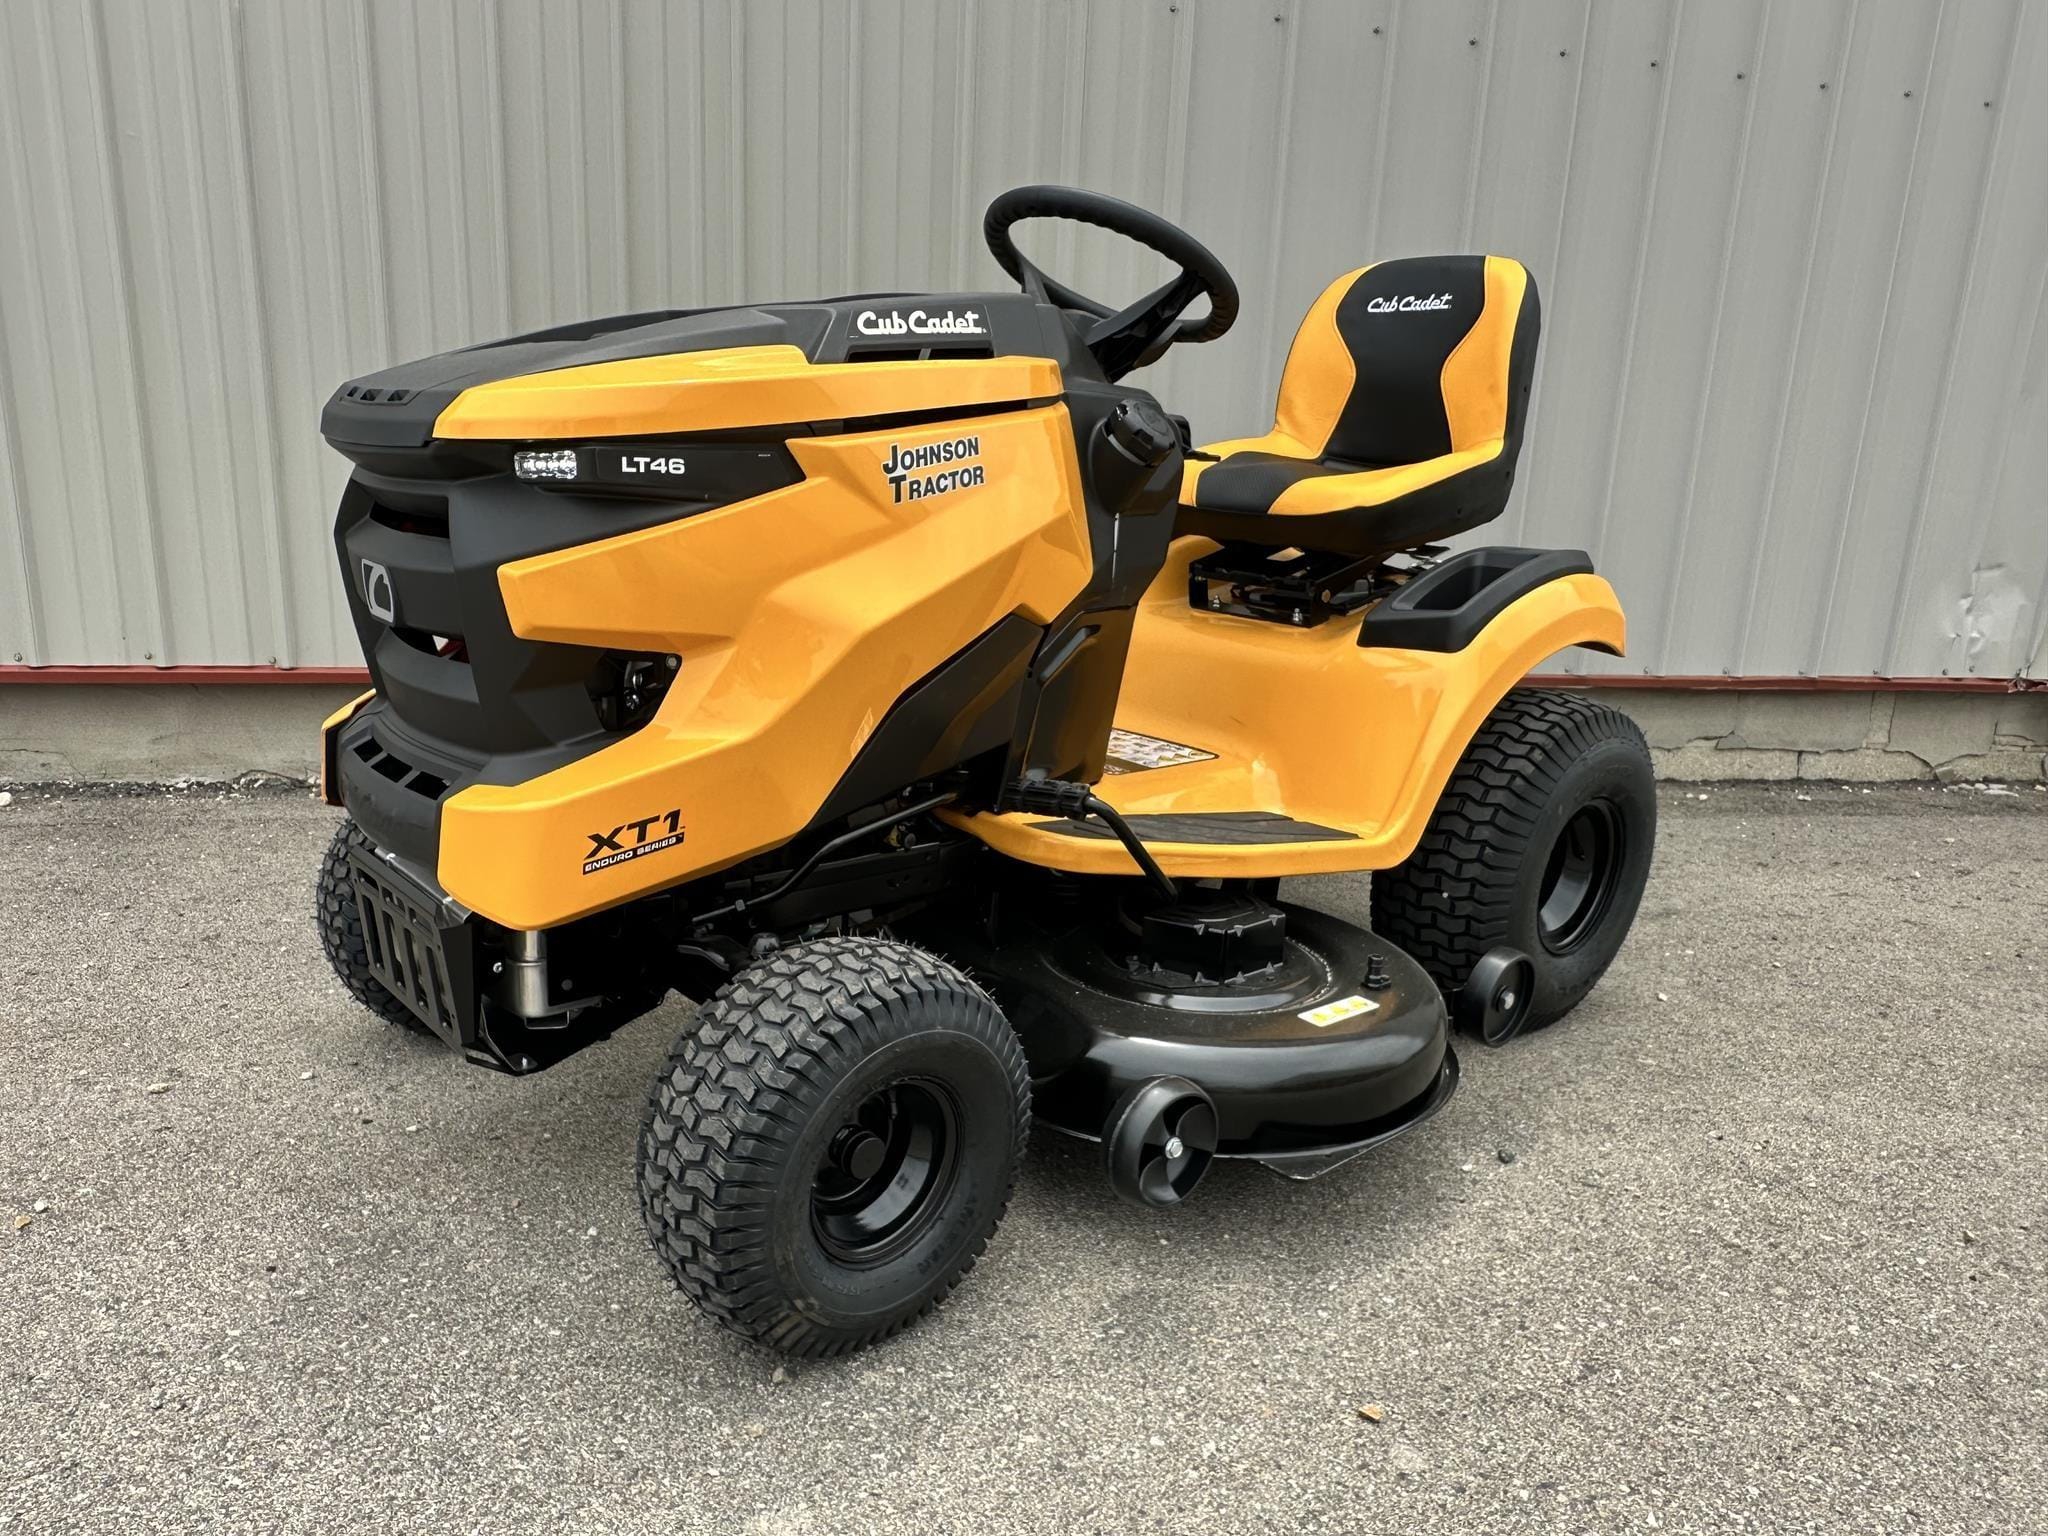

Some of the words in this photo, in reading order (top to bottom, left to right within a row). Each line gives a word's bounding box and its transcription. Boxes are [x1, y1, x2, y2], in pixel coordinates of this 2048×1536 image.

[1367, 295, 1398, 313] Cub
[1398, 293, 1453, 312] Cadet
[857, 310, 908, 335] Cub
[908, 310, 982, 334] Cadet
[621, 456, 686, 475] LT46
[882, 437, 979, 474] JOHNSON
[888, 465, 984, 503] TRACTOR
[584, 808, 681, 861] XT1
[584, 850, 634, 872] ENDURO
[636, 836, 678, 855] SERIES
